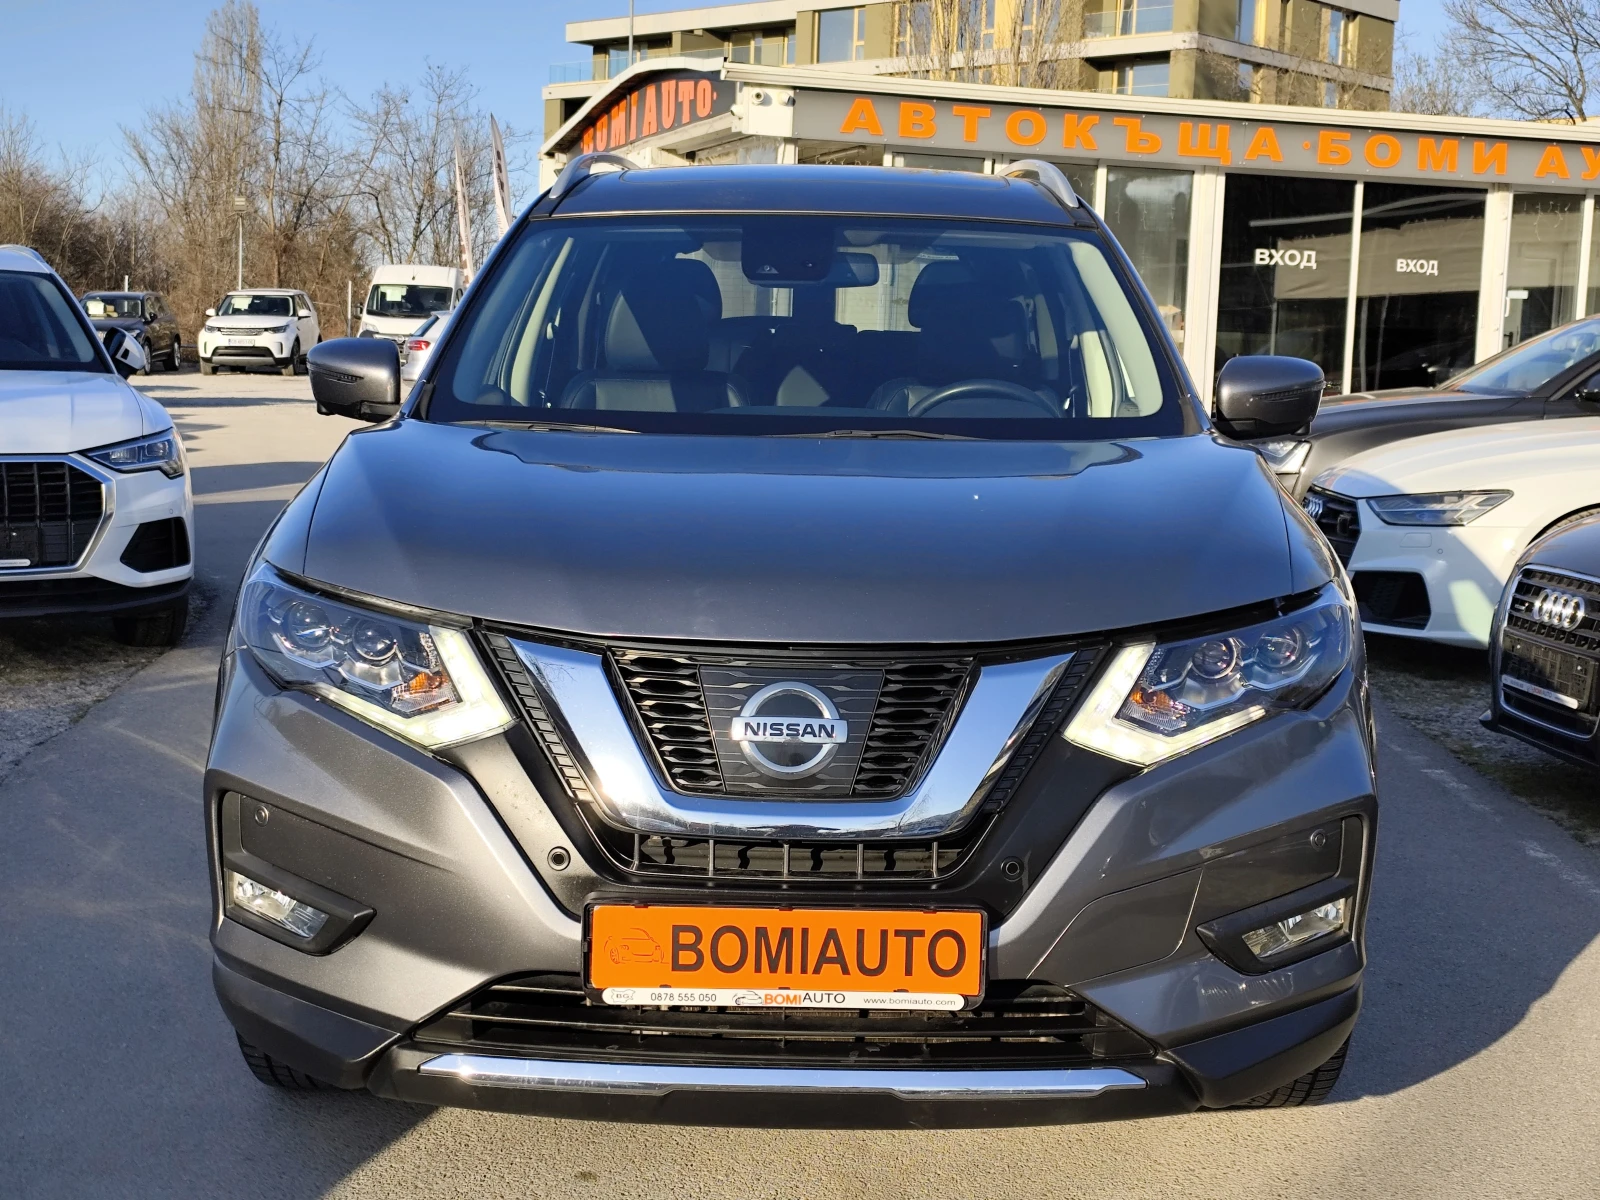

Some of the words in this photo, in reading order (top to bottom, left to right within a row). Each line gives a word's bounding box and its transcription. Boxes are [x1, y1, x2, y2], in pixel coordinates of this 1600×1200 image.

[583, 79, 712, 154] BOMIAUTO
[841, 97, 1283, 166] АВТОКЪЩА
[1317, 131, 1508, 175] БОМИ
[1255, 249, 1317, 270] ВХОД
[1396, 258, 1439, 276] ВХОД
[744, 721, 836, 738] NISSAN
[670, 924, 967, 978] BOMIAUTO
[650, 992, 675, 1002] 0878
[677, 993, 696, 1002] 555
[698, 993, 717, 1002] 050
[863, 997, 956, 1006] www.bomiauto.com
